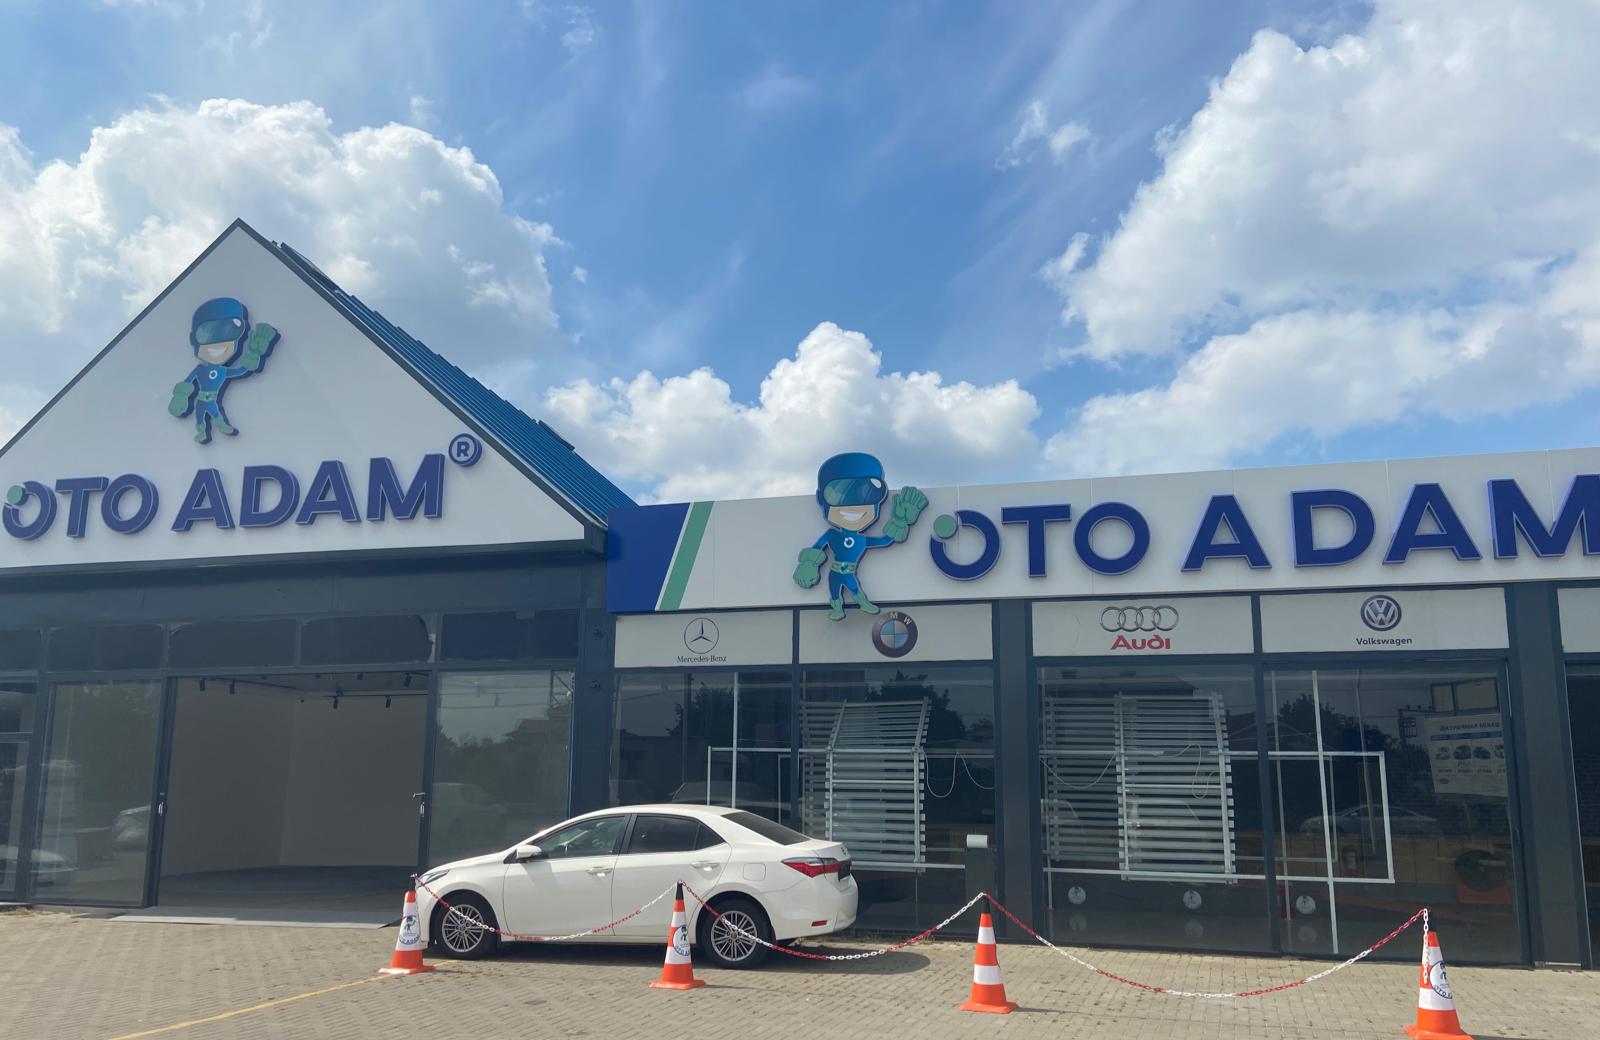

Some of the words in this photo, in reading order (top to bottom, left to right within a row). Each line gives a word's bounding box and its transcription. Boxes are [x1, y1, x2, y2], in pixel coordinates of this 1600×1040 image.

[2, 473, 159, 540] OTO
[171, 453, 445, 532] ADAM
[929, 501, 1150, 581] OTO
[1180, 473, 1600, 572] ADAM
[1110, 634, 1171, 650] Audi
[1356, 638, 1412, 646] Volkswagen
[677, 655, 727, 663] Mercedes-Benz
